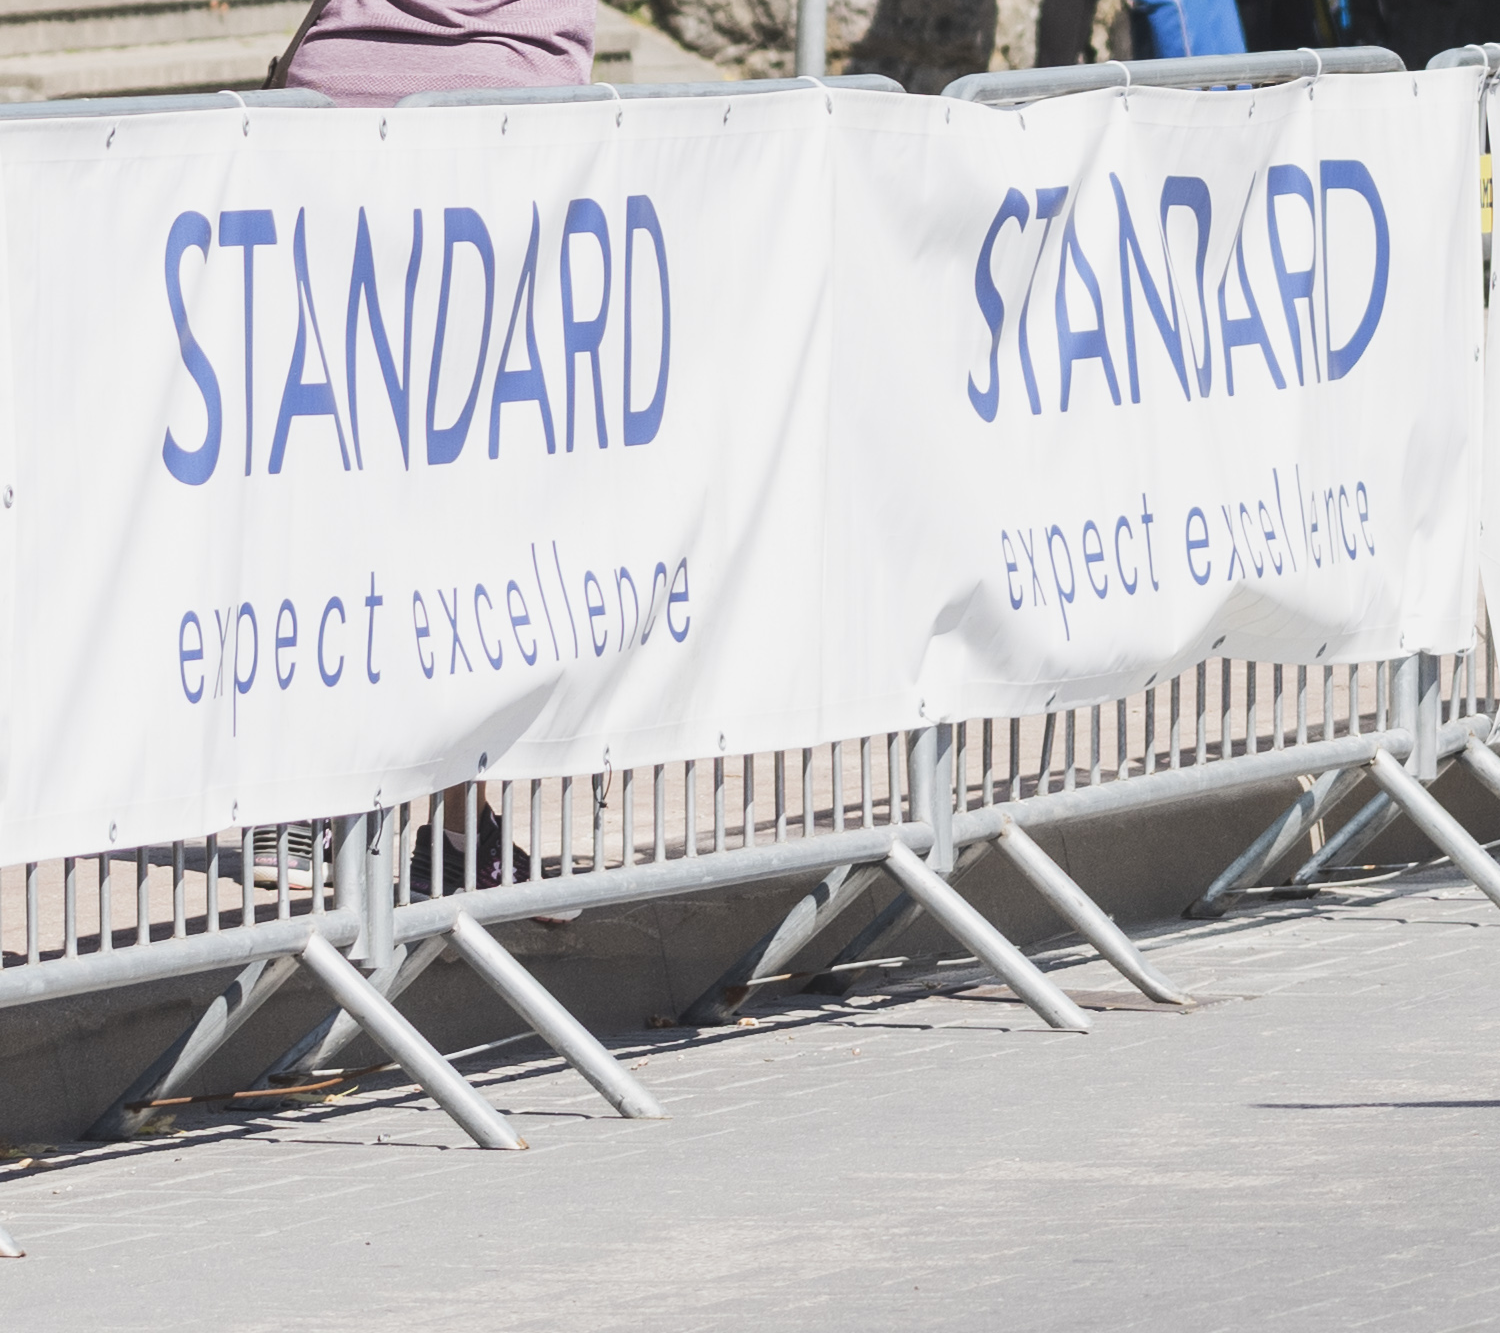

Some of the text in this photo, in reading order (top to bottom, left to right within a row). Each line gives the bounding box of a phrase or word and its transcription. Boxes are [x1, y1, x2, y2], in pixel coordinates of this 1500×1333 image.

[163, 194, 671, 486] STANDARD
[967, 160, 1391, 423] STANDARD
[179, 540, 692, 737] expect excellence
[1000, 463, 1376, 641] expect excellence
